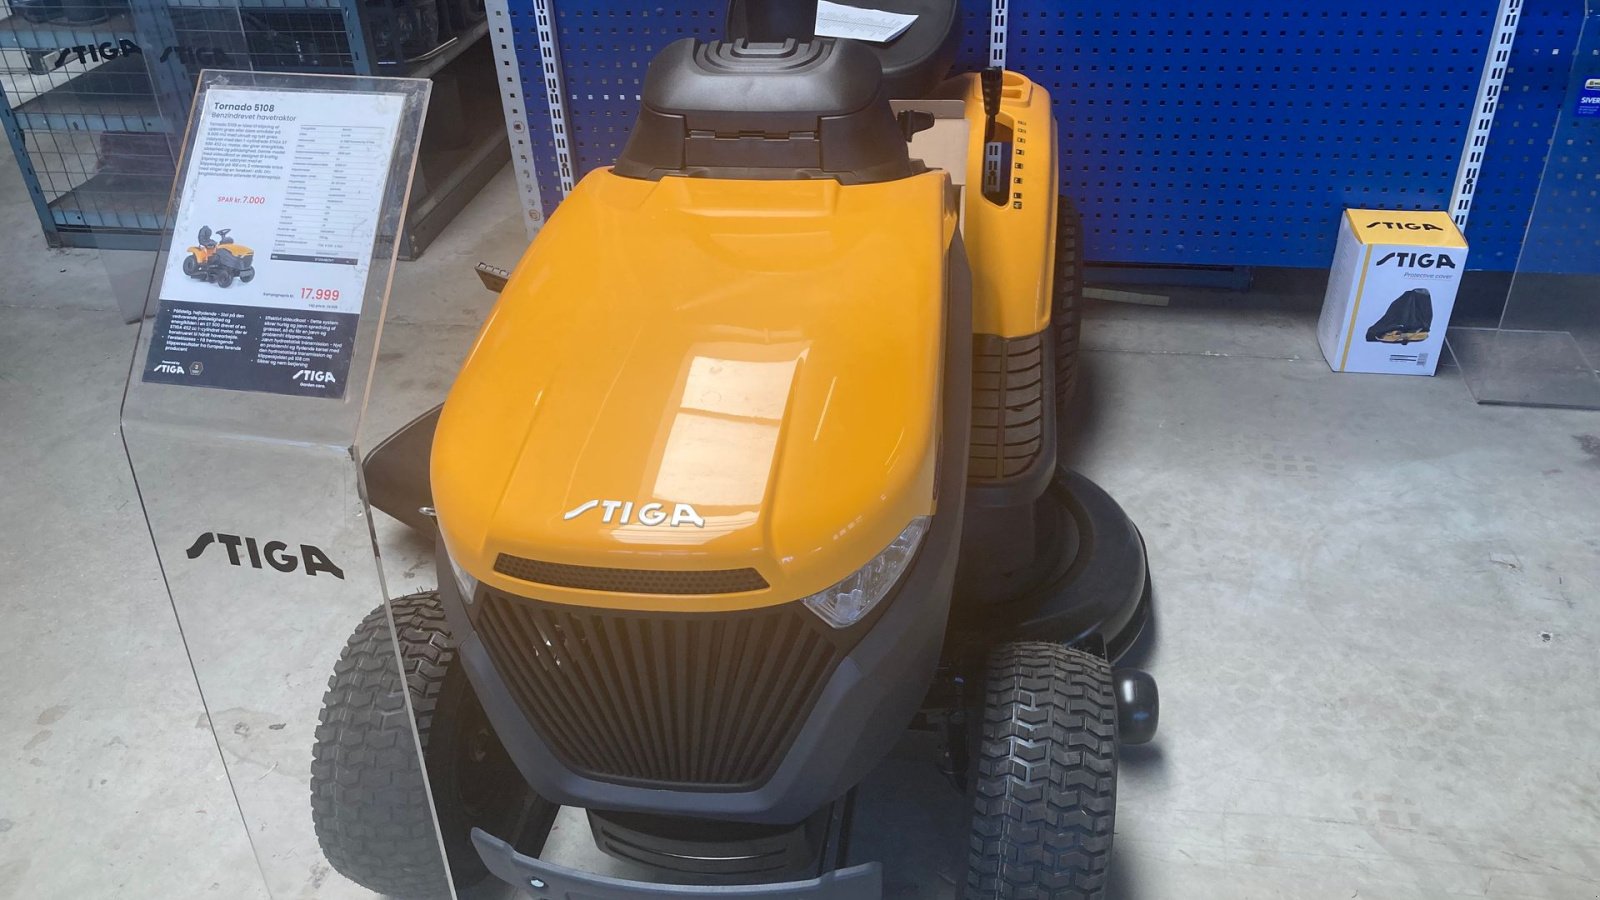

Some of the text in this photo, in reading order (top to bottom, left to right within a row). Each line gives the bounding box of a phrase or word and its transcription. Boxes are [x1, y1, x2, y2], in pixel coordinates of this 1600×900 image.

[55, 39, 142, 68] STIGA
[213, 102, 252, 110] Tornado
[243, 196, 266, 204] 7.000
[1366, 222, 1444, 231] STIGA
[1376, 252, 1456, 269] STIGA
[1403, 271, 1434, 279] Protective
[301, 288, 340, 301] 17.999
[154, 364, 184, 374] STIGA
[292, 370, 336, 382] STIGA
[564, 499, 705, 528] STIGA
[186, 532, 345, 580] STIGA
